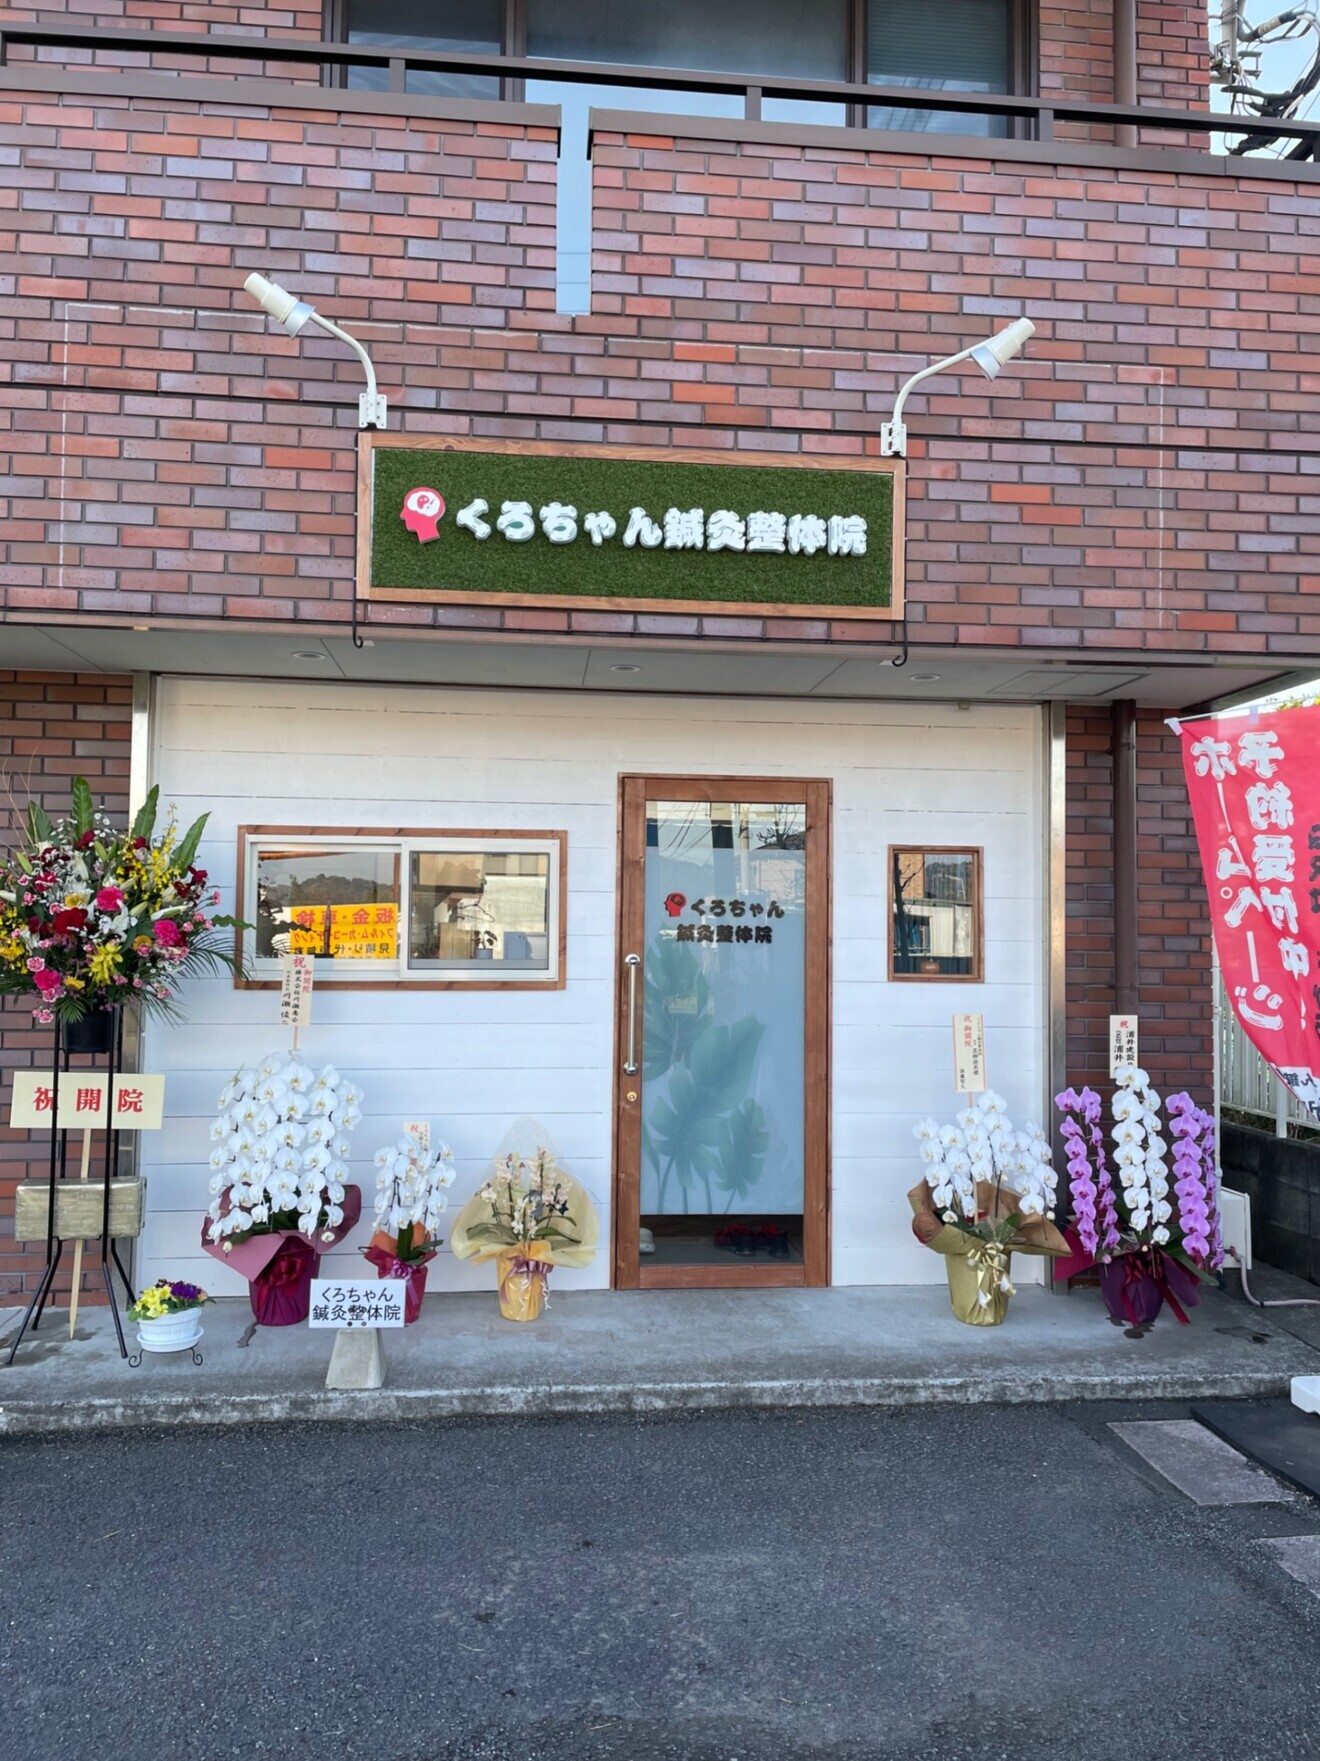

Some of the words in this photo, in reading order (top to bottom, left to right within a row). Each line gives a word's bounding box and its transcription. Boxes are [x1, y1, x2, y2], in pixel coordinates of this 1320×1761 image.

[456, 498, 867, 556] くろちゃん鍼灸整体院
[691, 899, 785, 918] くろちゃん
[677, 924, 773, 943] 鍼灸整体院
[292, 956, 306, 968] 祝
[33, 1087, 143, 1113] 祝開院
[321, 1287, 394, 1303] くろちゃん
[312, 1304, 401, 1321] 鍼灸整体院
